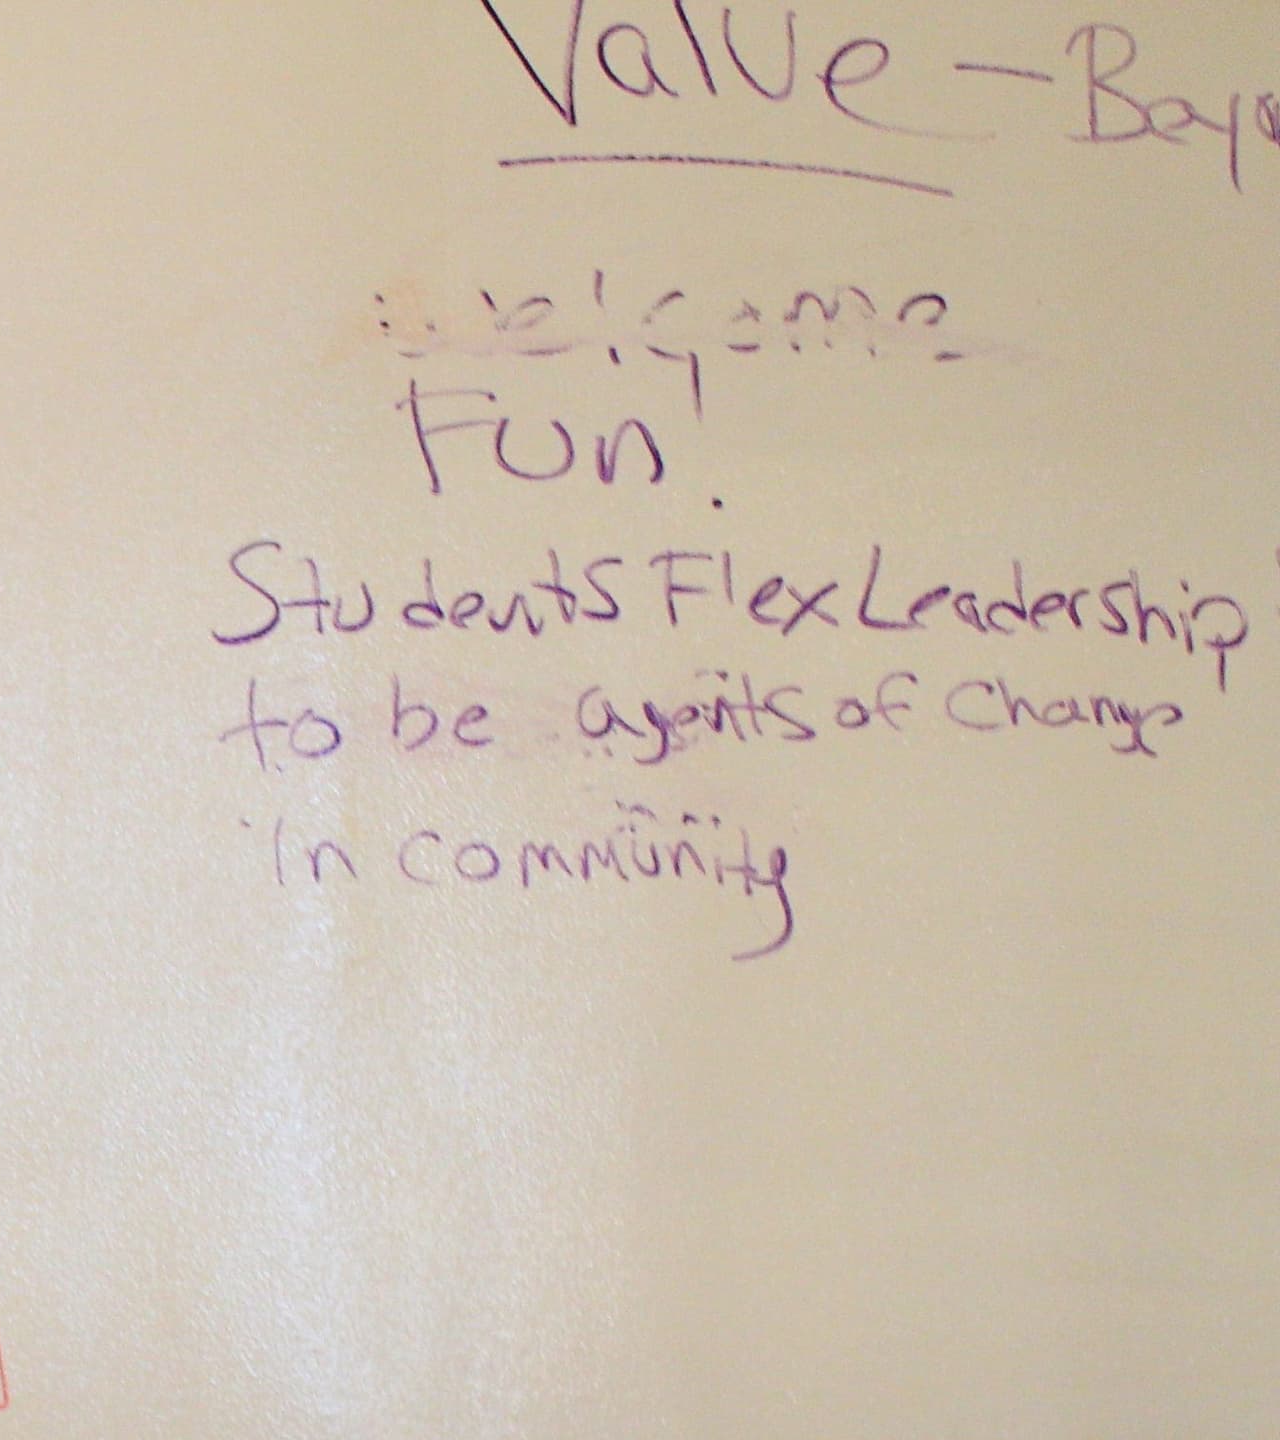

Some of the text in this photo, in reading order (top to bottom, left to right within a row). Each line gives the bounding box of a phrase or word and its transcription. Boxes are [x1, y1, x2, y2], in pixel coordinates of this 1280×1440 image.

[649, 550, 839, 637] Flex
[858, 545, 1249, 694] Leadership
[219, 679, 342, 772] to
[392, 676, 493, 751] be
[835, 672, 918, 730] of
[399, 824, 794, 962] community
